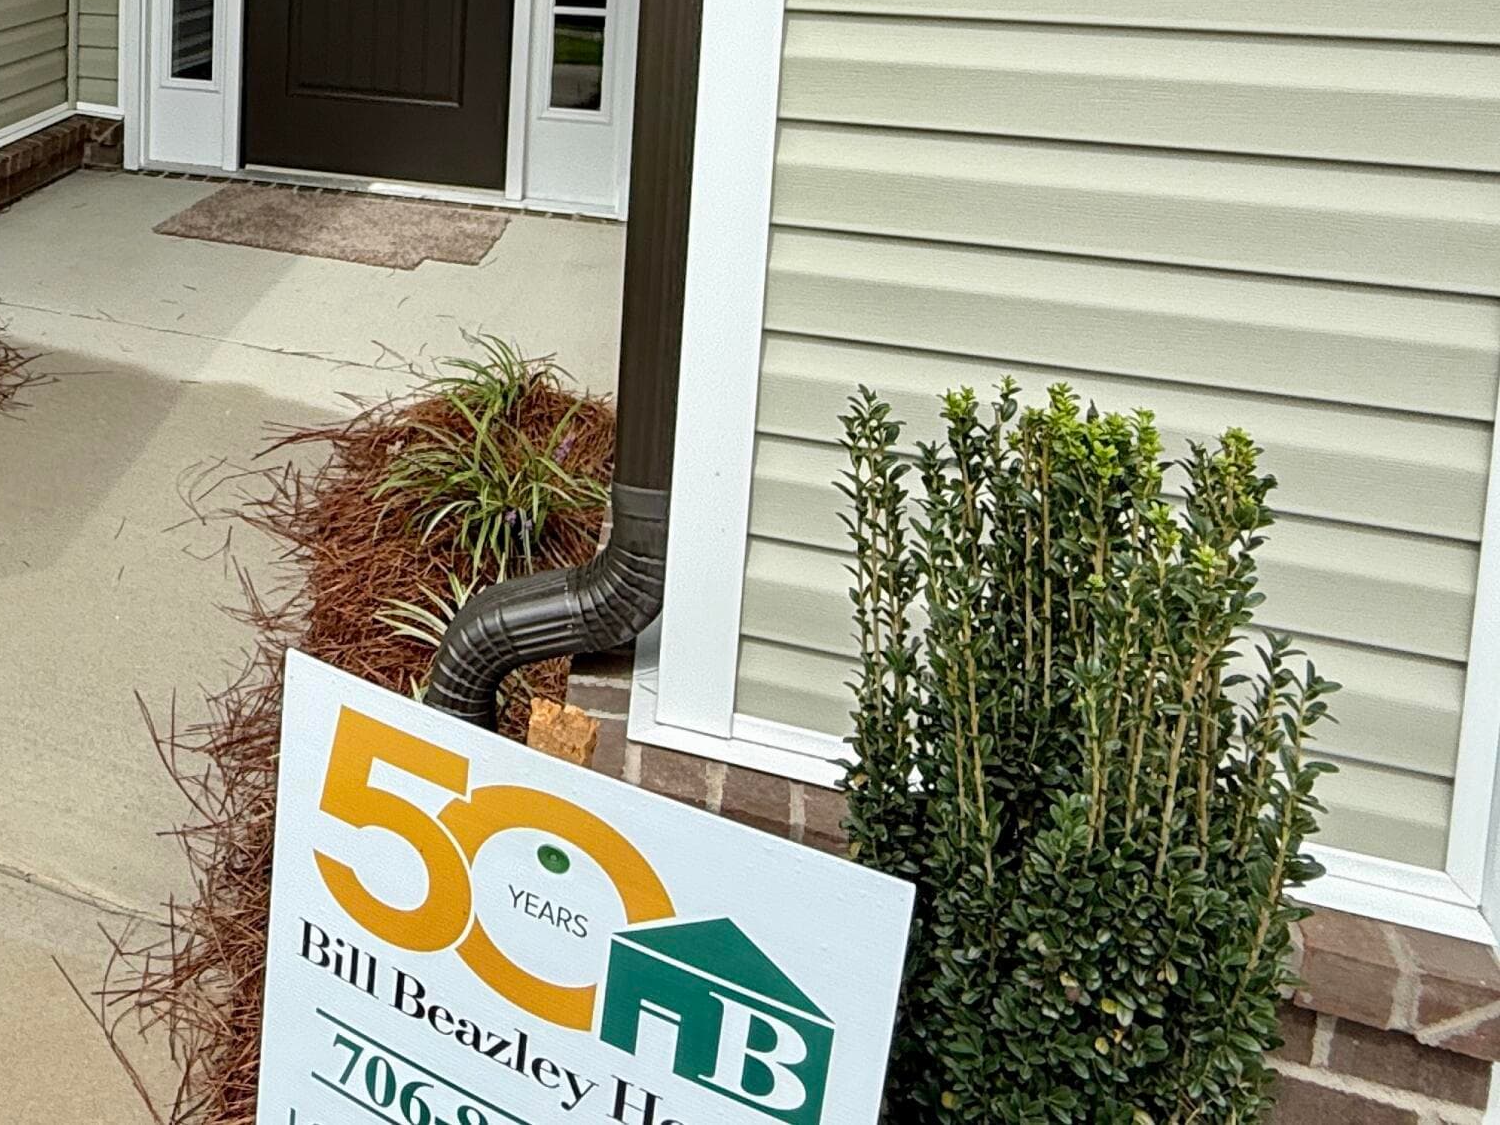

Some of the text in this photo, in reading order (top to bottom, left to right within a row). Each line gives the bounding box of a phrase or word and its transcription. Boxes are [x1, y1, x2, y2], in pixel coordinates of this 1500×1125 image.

[313, 704, 676, 1032] 50
[507, 884, 590, 939] YEARS
[297, 917, 685, 1125] Bill Beazley H
